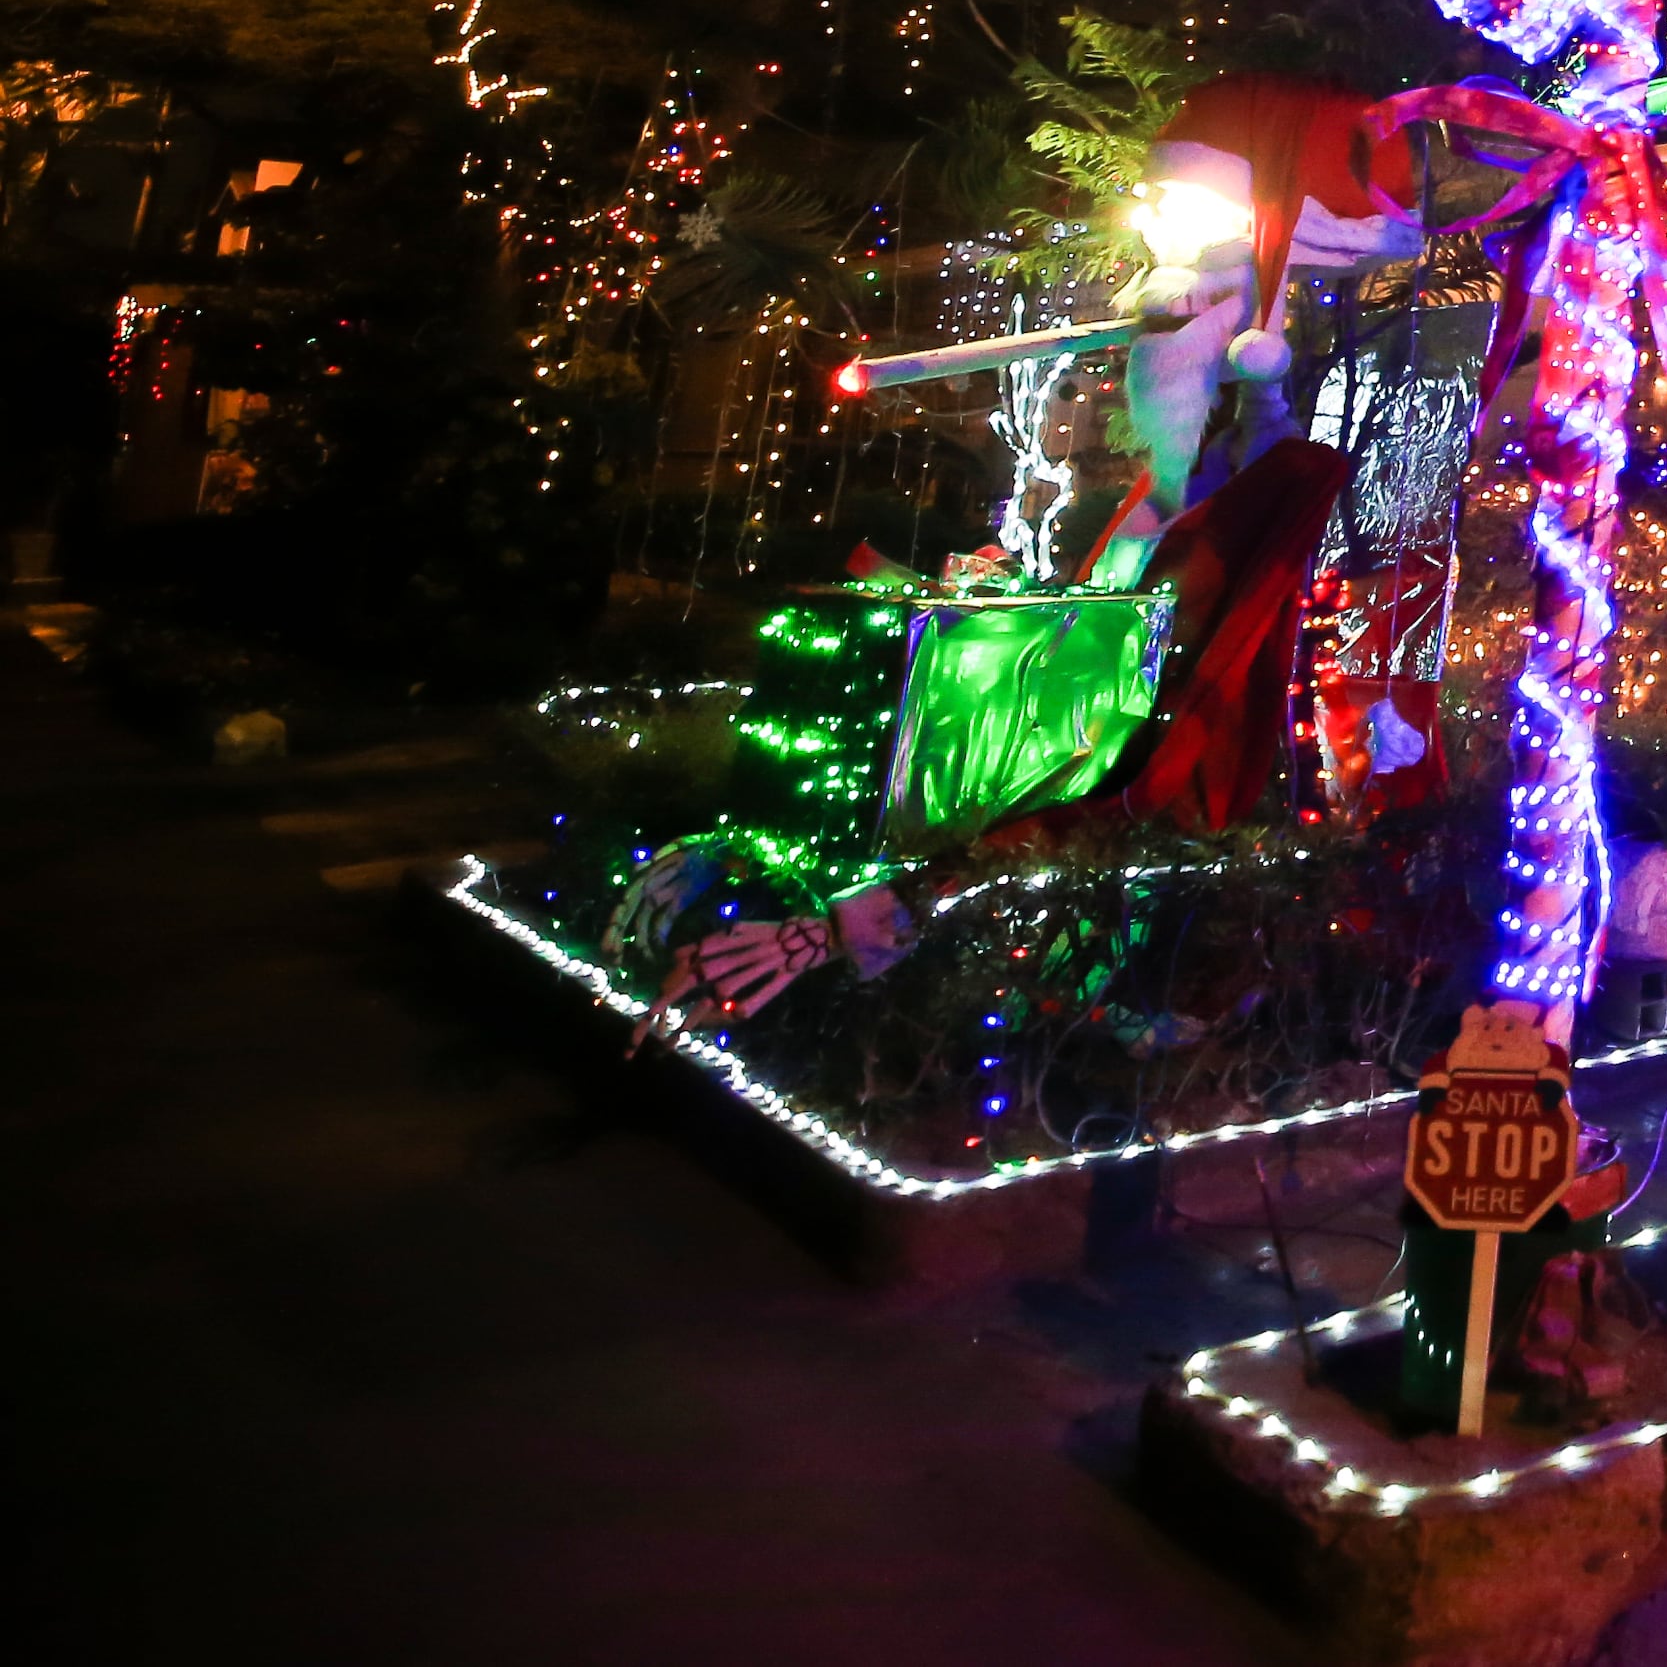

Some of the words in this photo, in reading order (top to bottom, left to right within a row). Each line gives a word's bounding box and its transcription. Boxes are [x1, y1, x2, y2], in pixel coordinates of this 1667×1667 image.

[1446, 1089, 1542, 1117] SANTA
[1424, 1121, 1558, 1180] STOP
[1451, 1186, 1526, 1214] HERE
